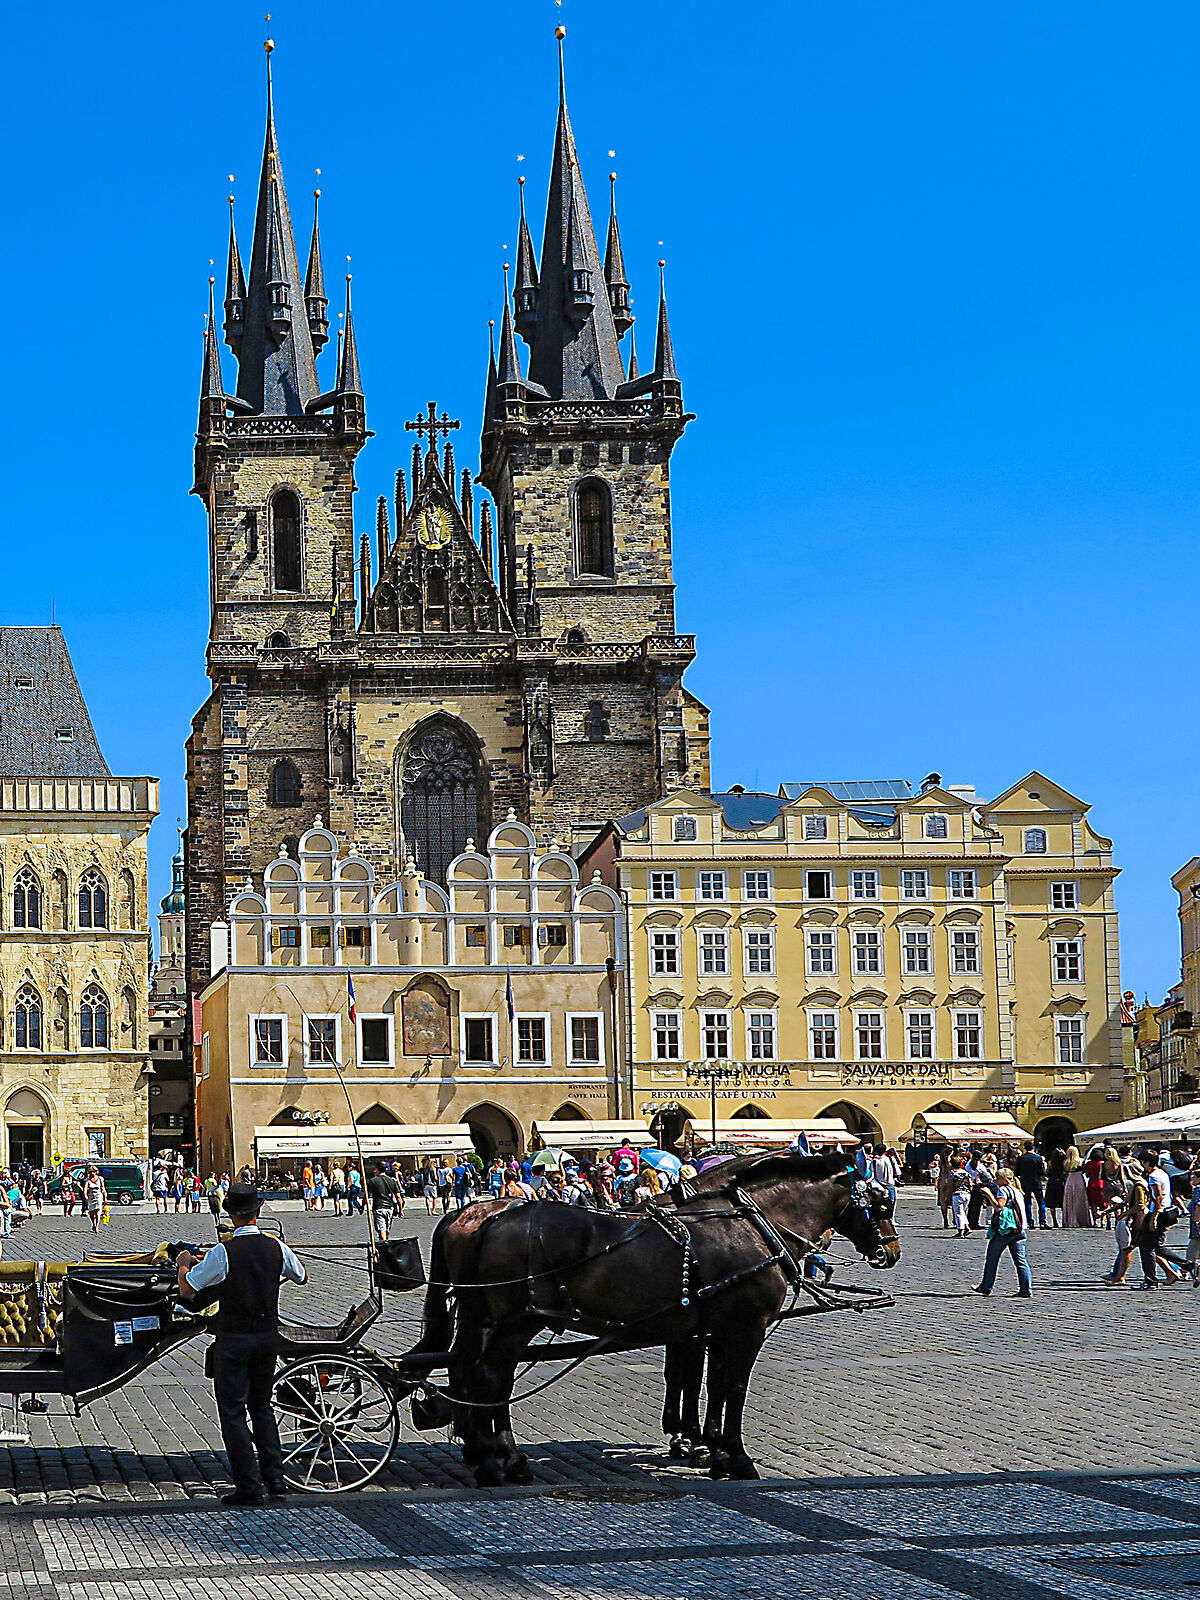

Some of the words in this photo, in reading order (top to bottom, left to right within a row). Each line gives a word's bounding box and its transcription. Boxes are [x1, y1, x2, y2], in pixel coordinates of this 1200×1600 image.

[743, 1065, 791, 1076] MUCHA
[844, 1064, 914, 1076] SALVADOR
[651, 1091, 711, 1099] RESTAURANT
[741, 1091, 748, 1099] U
